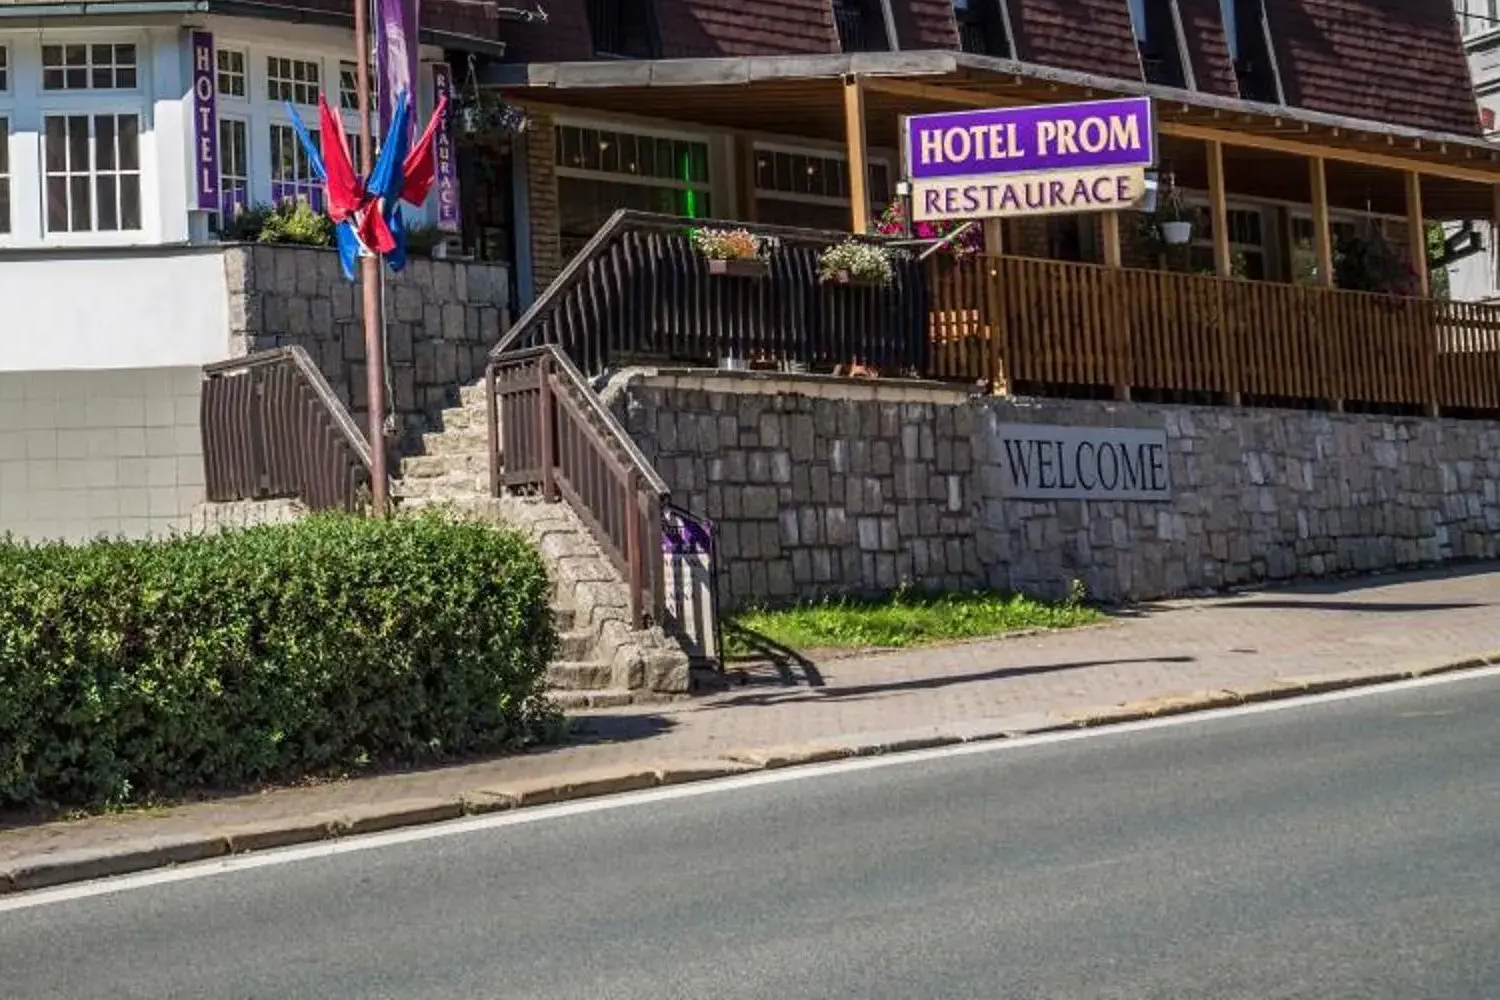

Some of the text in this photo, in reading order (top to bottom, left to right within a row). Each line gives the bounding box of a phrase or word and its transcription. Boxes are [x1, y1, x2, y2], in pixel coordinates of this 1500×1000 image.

[197, 47, 213, 193] HOTEL
[920, 114, 1141, 164] HOTEL PROM
[924, 175, 1132, 214] RESTAURACE
[1003, 439, 1167, 491] WELCOME
